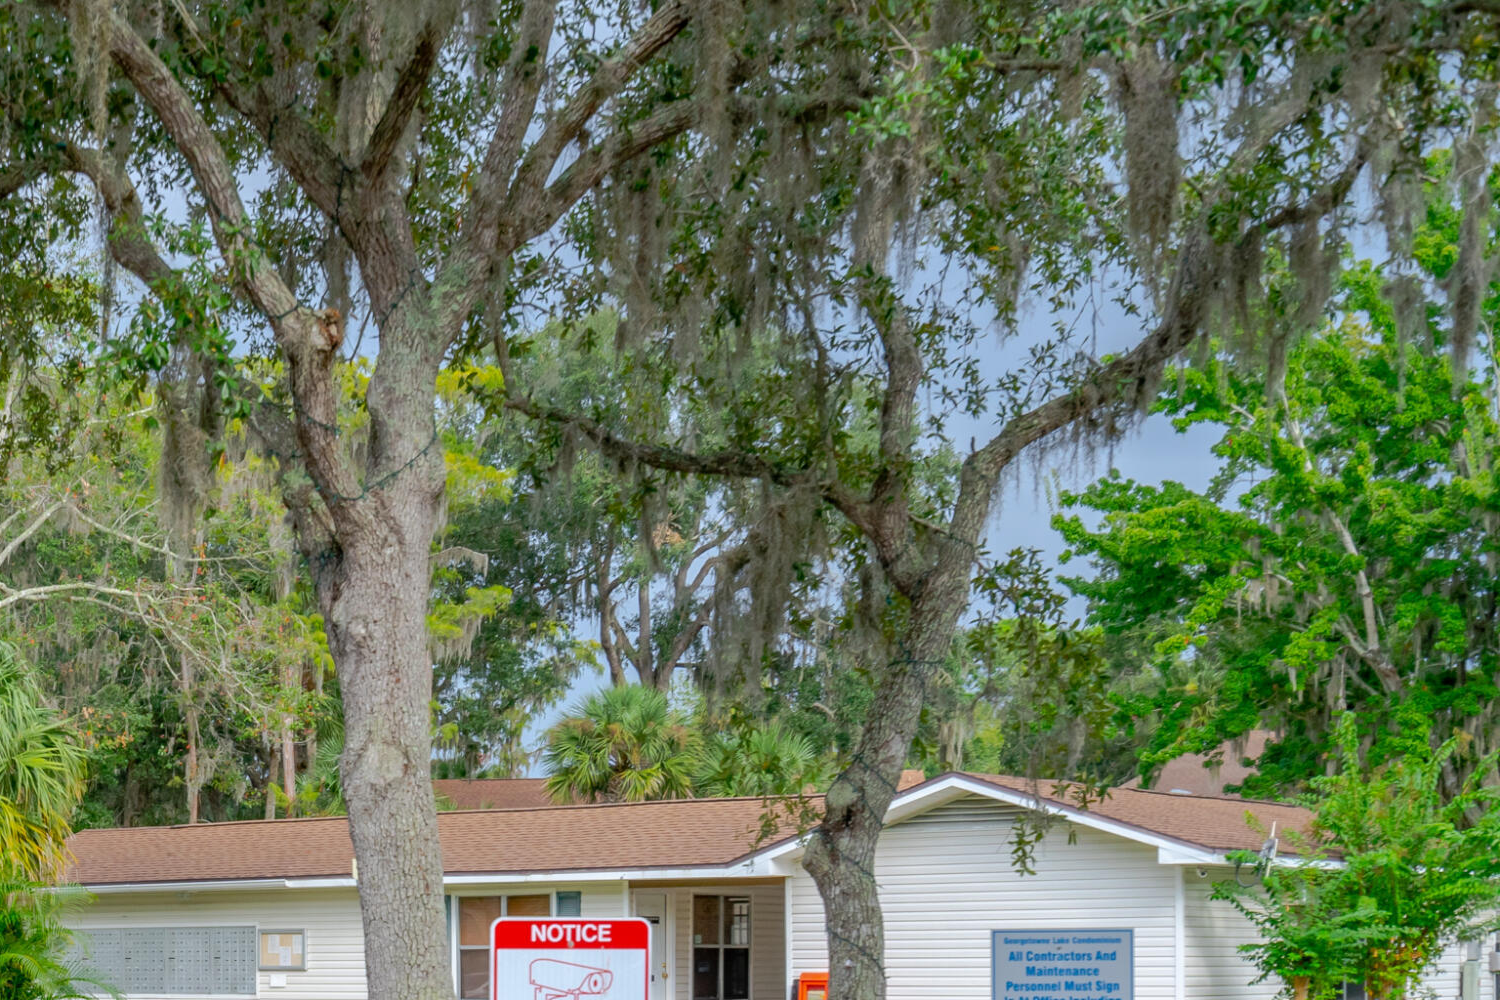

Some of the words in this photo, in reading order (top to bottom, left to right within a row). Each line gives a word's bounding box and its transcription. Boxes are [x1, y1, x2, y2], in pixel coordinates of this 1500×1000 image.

[530, 923, 613, 943] NOTICE
[1008, 951, 1023, 962] All
[1025, 951, 1093, 962] Contractors
[1095, 950, 1117, 961] And
[1025, 966, 1101, 977] Maintenance
[1005, 981, 1062, 992] Personnel
[1064, 980, 1093, 991] Must
[1095, 980, 1120, 993] Sign
